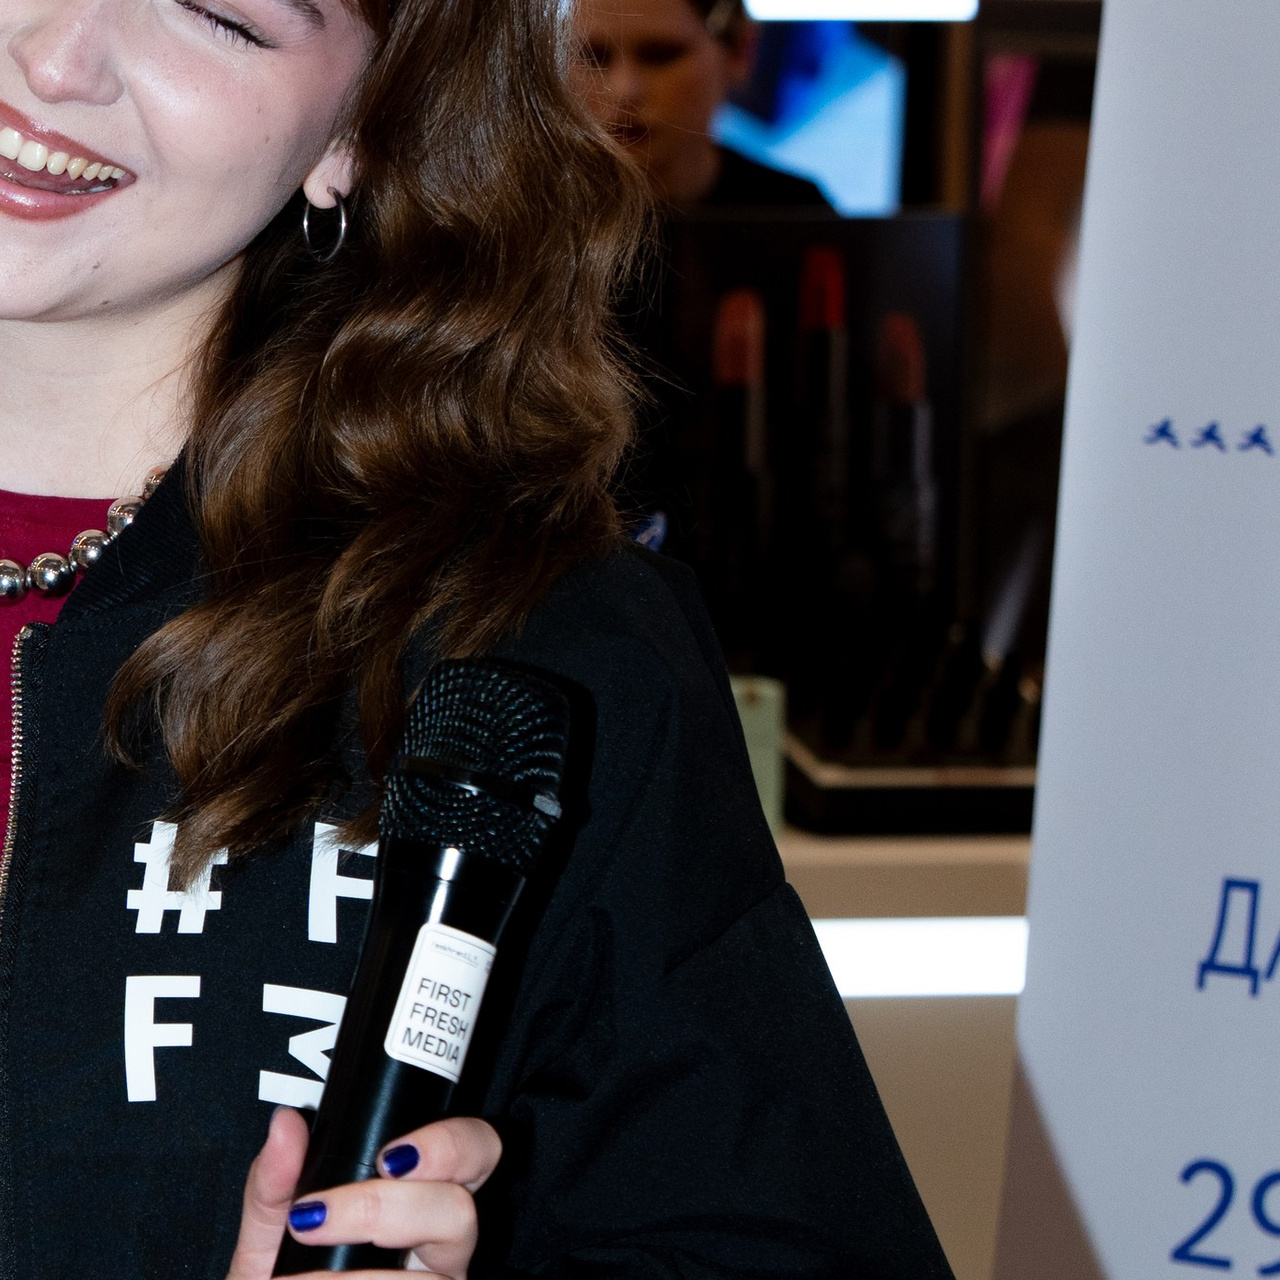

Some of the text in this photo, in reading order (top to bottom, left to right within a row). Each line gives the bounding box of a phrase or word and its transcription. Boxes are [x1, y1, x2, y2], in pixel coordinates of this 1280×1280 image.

[1196, 877, 1280, 999] Д
[418, 977, 472, 1011] FIRST
[125, 975, 201, 1102] F
[410, 1002, 469, 1041] FRESH
[402, 1027, 460, 1065] MEDIA
